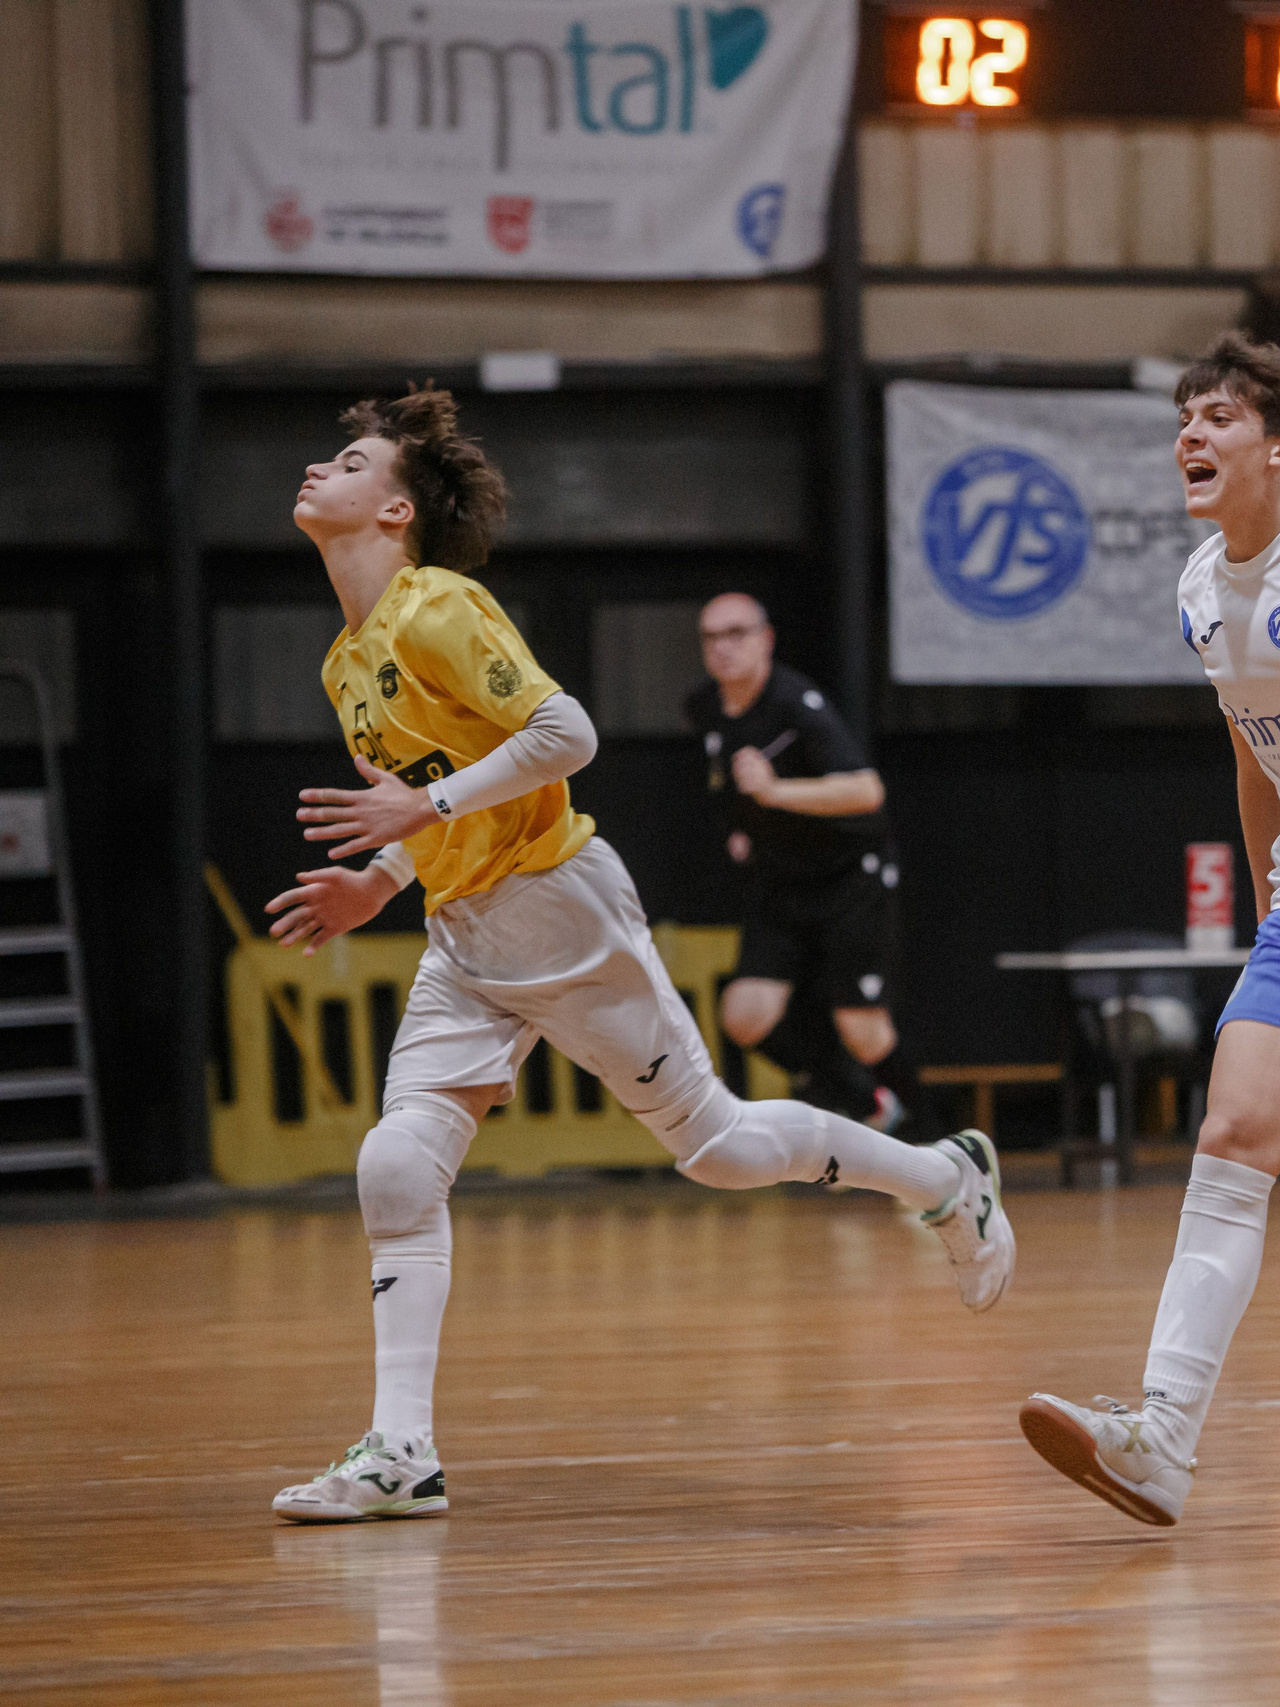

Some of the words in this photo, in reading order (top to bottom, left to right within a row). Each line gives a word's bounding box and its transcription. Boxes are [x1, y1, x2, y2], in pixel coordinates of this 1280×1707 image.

[299, 0, 694, 174] Primtal
[917, 18, 1029, 106] 02
[1190, 848, 1225, 908] 5
